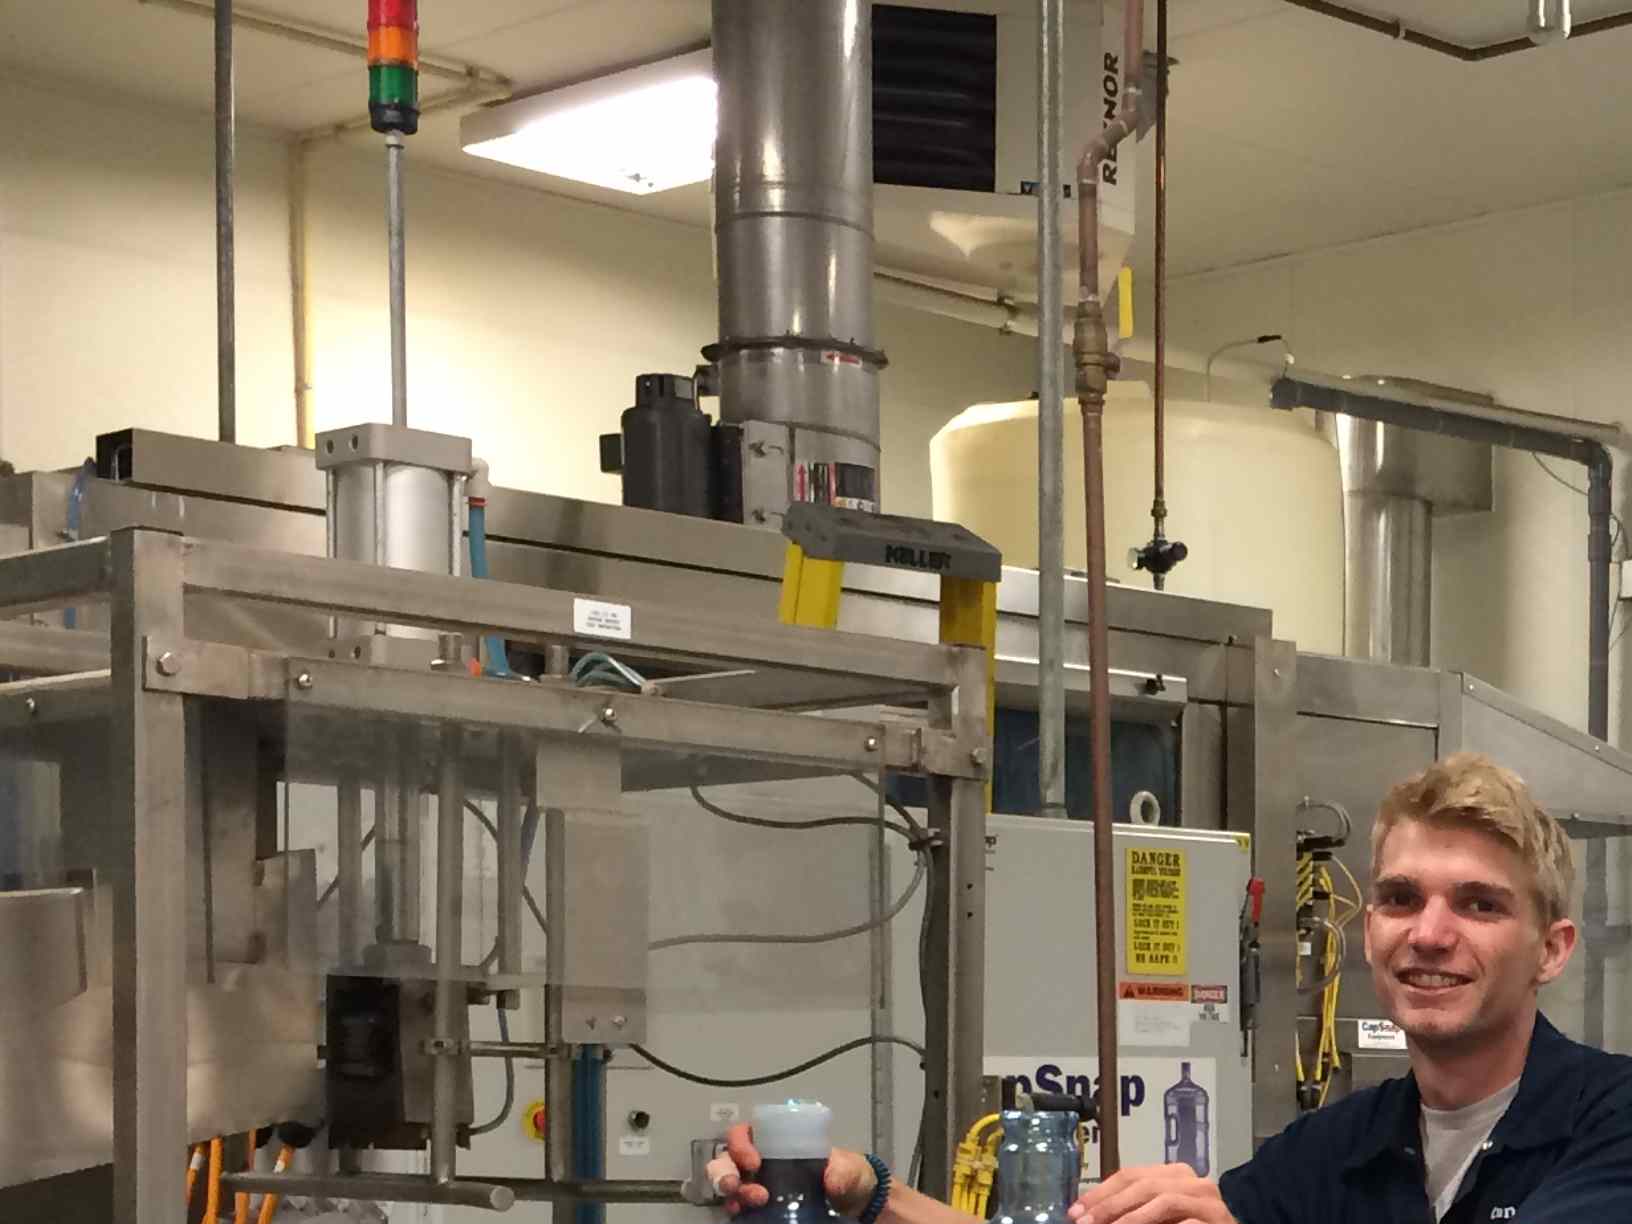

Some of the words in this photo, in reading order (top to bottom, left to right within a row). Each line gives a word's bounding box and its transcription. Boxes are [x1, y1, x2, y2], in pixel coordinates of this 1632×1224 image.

[1102, 52, 1119, 186] RENOR
[1131, 850, 1181, 866] DANGER
[1138, 986, 1184, 997] WARNING
